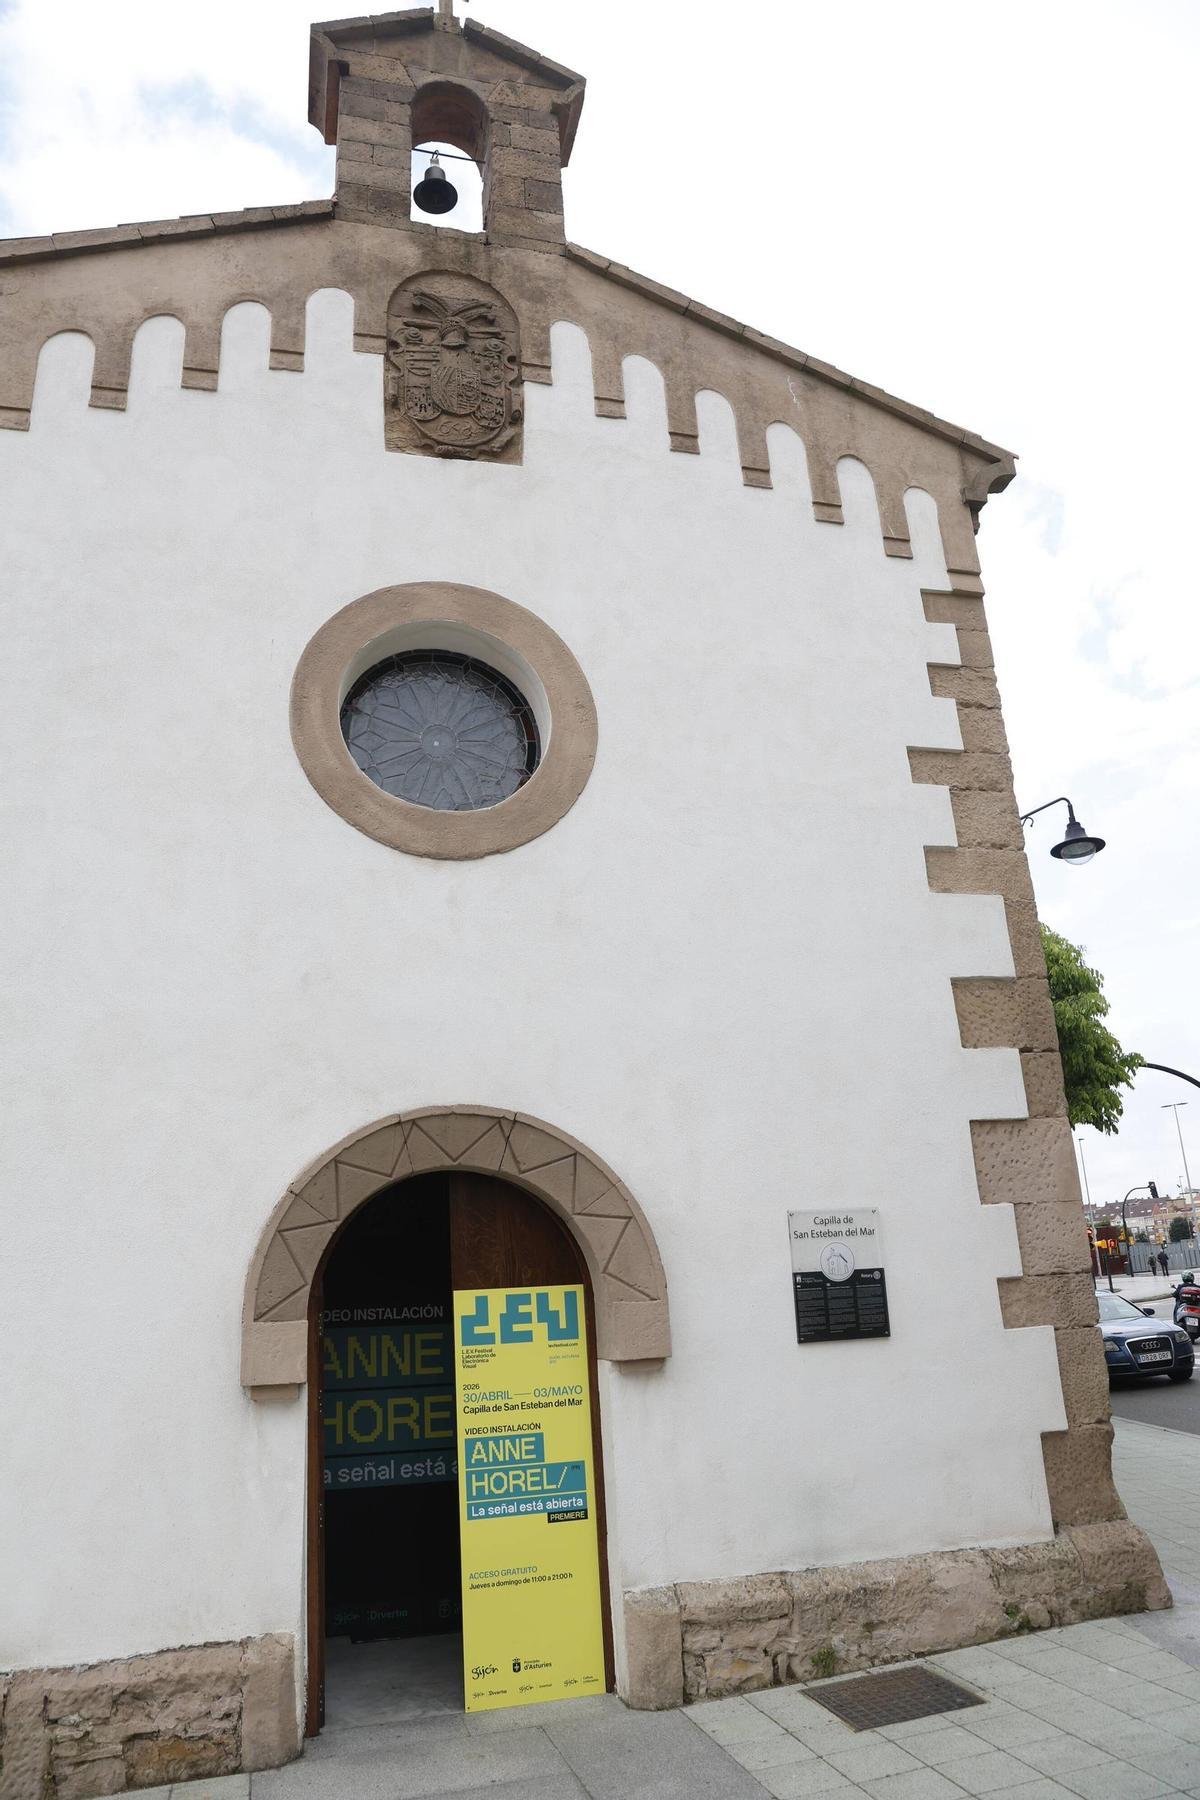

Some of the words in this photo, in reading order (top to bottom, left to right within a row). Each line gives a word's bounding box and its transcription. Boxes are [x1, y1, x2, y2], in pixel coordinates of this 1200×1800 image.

[814, 1216, 841, 1226] Capilla
[843, 1215, 853, 1224] de
[793, 1230, 809, 1239] San
[811, 1229, 843, 1238] Esteban
[845, 1228, 858, 1237] del
[860, 1227, 875, 1236] Mar
[324, 1310, 351, 1322] DEO
[354, 1304, 443, 1321] INSTALACIÓN
[324, 1333, 444, 1379] ANNE
[463, 1383, 480, 1391] 2026
[463, 1390, 512, 1404] 30/ABRIL
[533, 1385, 583, 1399] 03/MAYO
[463, 1403, 491, 1415] Capilla
[492, 1402, 502, 1412] de
[503, 1402, 520, 1411] San
[521, 1399, 553, 1410] Esteban
[554, 1398, 567, 1408] del
[568, 1397, 583, 1406] Mar
[324, 1395, 453, 1444] HORE
[465, 1426, 489, 1436] VIDEO
[490, 1422, 541, 1433] INSTALACIÓN
[471, 1437, 536, 1464] ANNE
[324, 1469, 332, 1484] a
[338, 1460, 395, 1483] señal
[400, 1457, 446, 1479] está
[471, 1506, 485, 1517] La
[488, 1502, 517, 1515] señal
[520, 1500, 543, 1512] está
[546, 1496, 583, 1509] abierta
[550, 1511, 585, 1521] PREMIERE
[469, 1570, 500, 1580] ACCESO
[501, 1566, 538, 1576] GRATUITO
[469, 1582, 490, 1590] Jueves
[496, 1578, 522, 1587] domingo
[552, 1573, 568, 1581] 21:00
[524, 1662, 552, 1670] d'Asturies
